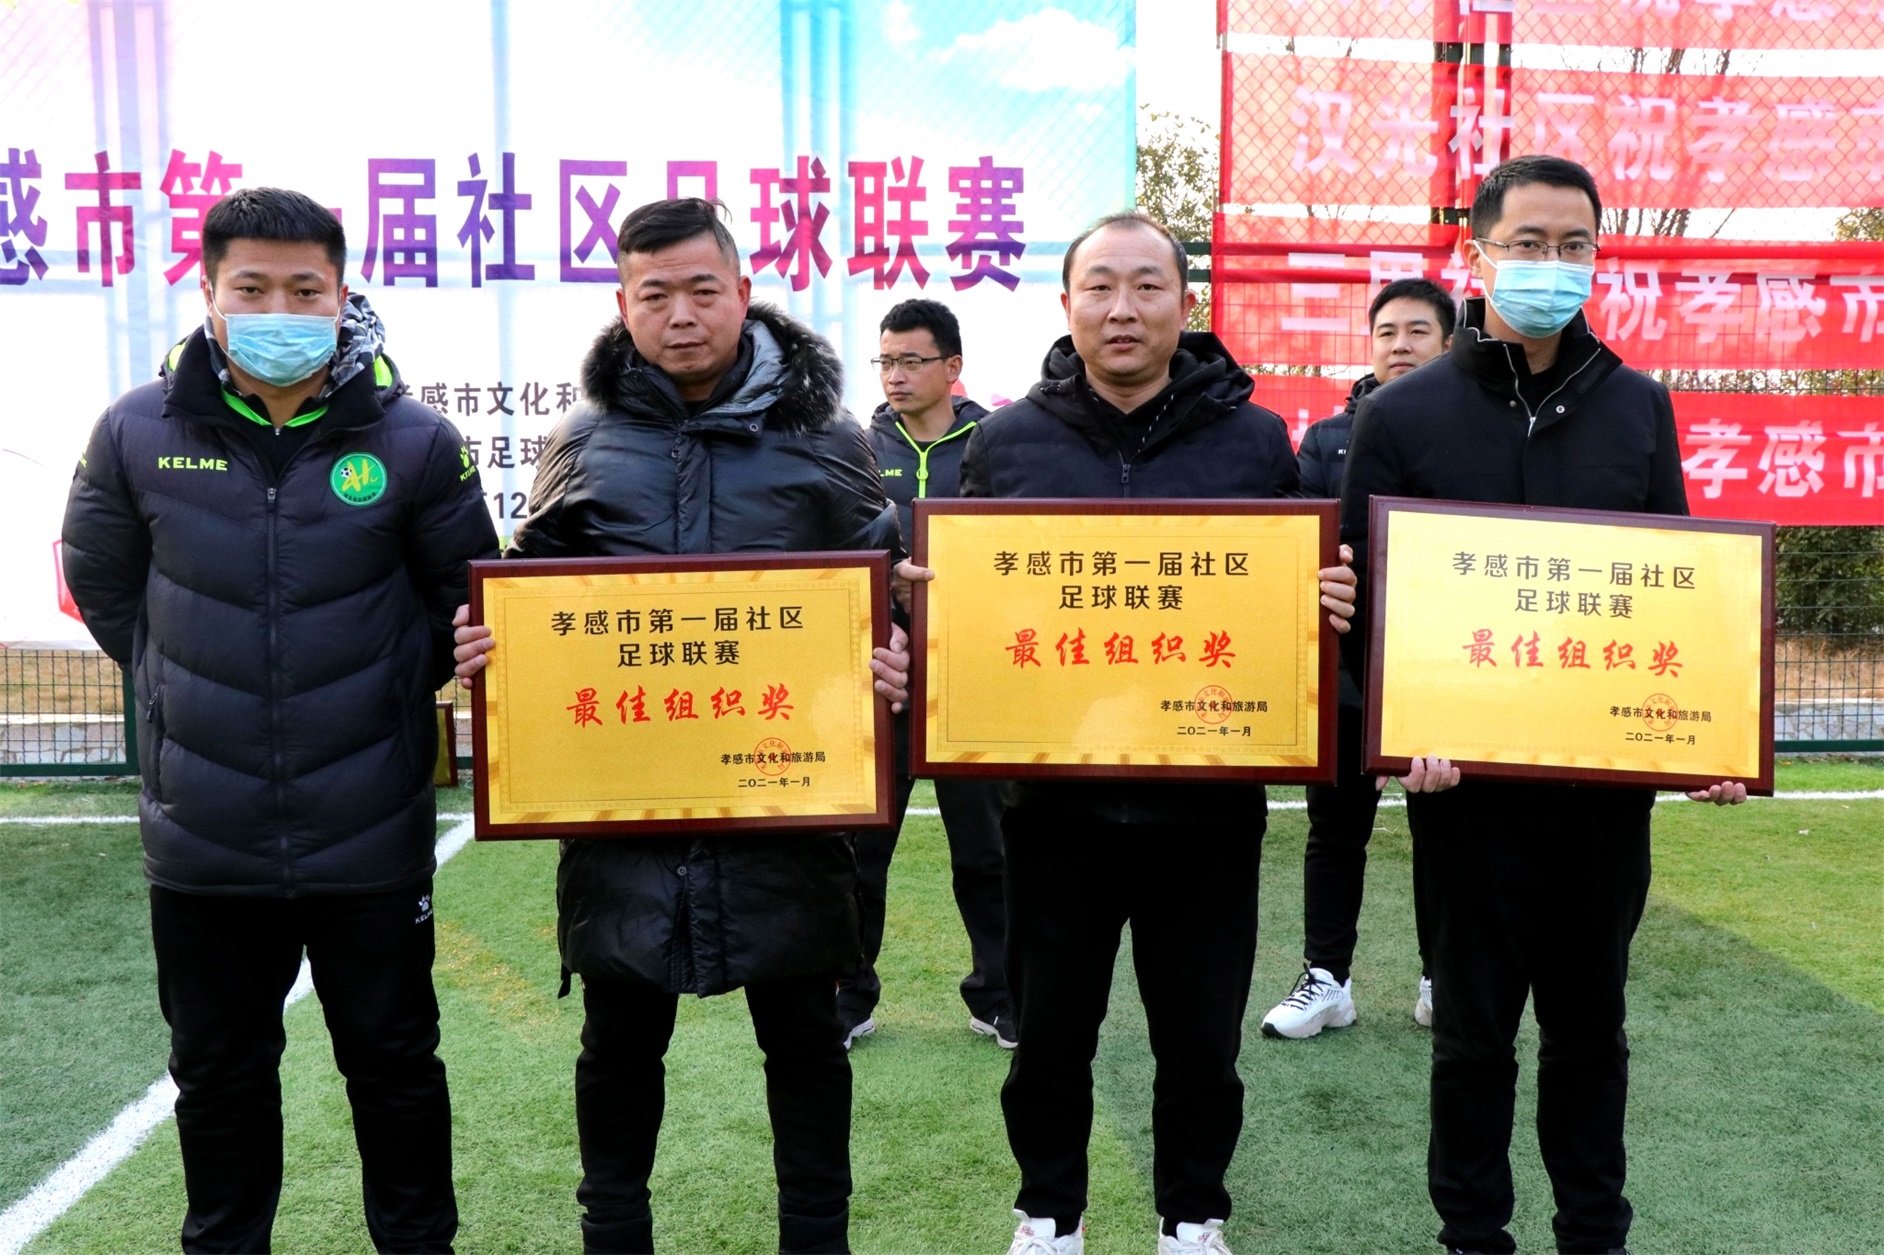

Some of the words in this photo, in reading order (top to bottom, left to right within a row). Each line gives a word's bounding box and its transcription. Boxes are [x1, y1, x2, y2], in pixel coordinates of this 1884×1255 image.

[0, 148, 1026, 291] 感市第届社区球联赛
[404, 381, 582, 416] 感市文化和
[158, 457, 228, 471] KELME
[993, 550, 1249, 577] 孝感市第一届社区
[1453, 551, 1696, 590] 孝感市第一届社区
[1059, 585, 1184, 610] 足球联赛
[1515, 588, 1634, 619] 足球联赛
[551, 605, 804, 637] 孝感市第一届社区
[617, 640, 741, 668] 足球联赛
[1005, 627, 1236, 669] 最佳组织奖
[1462, 628, 1683, 678] 最佳组织奖
[566, 683, 794, 728] 最佳组织奖
[1161, 700, 1268, 712] 孝感市文化和旅游局
[1610, 705, 1712, 722] 孝感市文化和旅游局
[721, 751, 826, 766] 孝感市文化和旅游局
